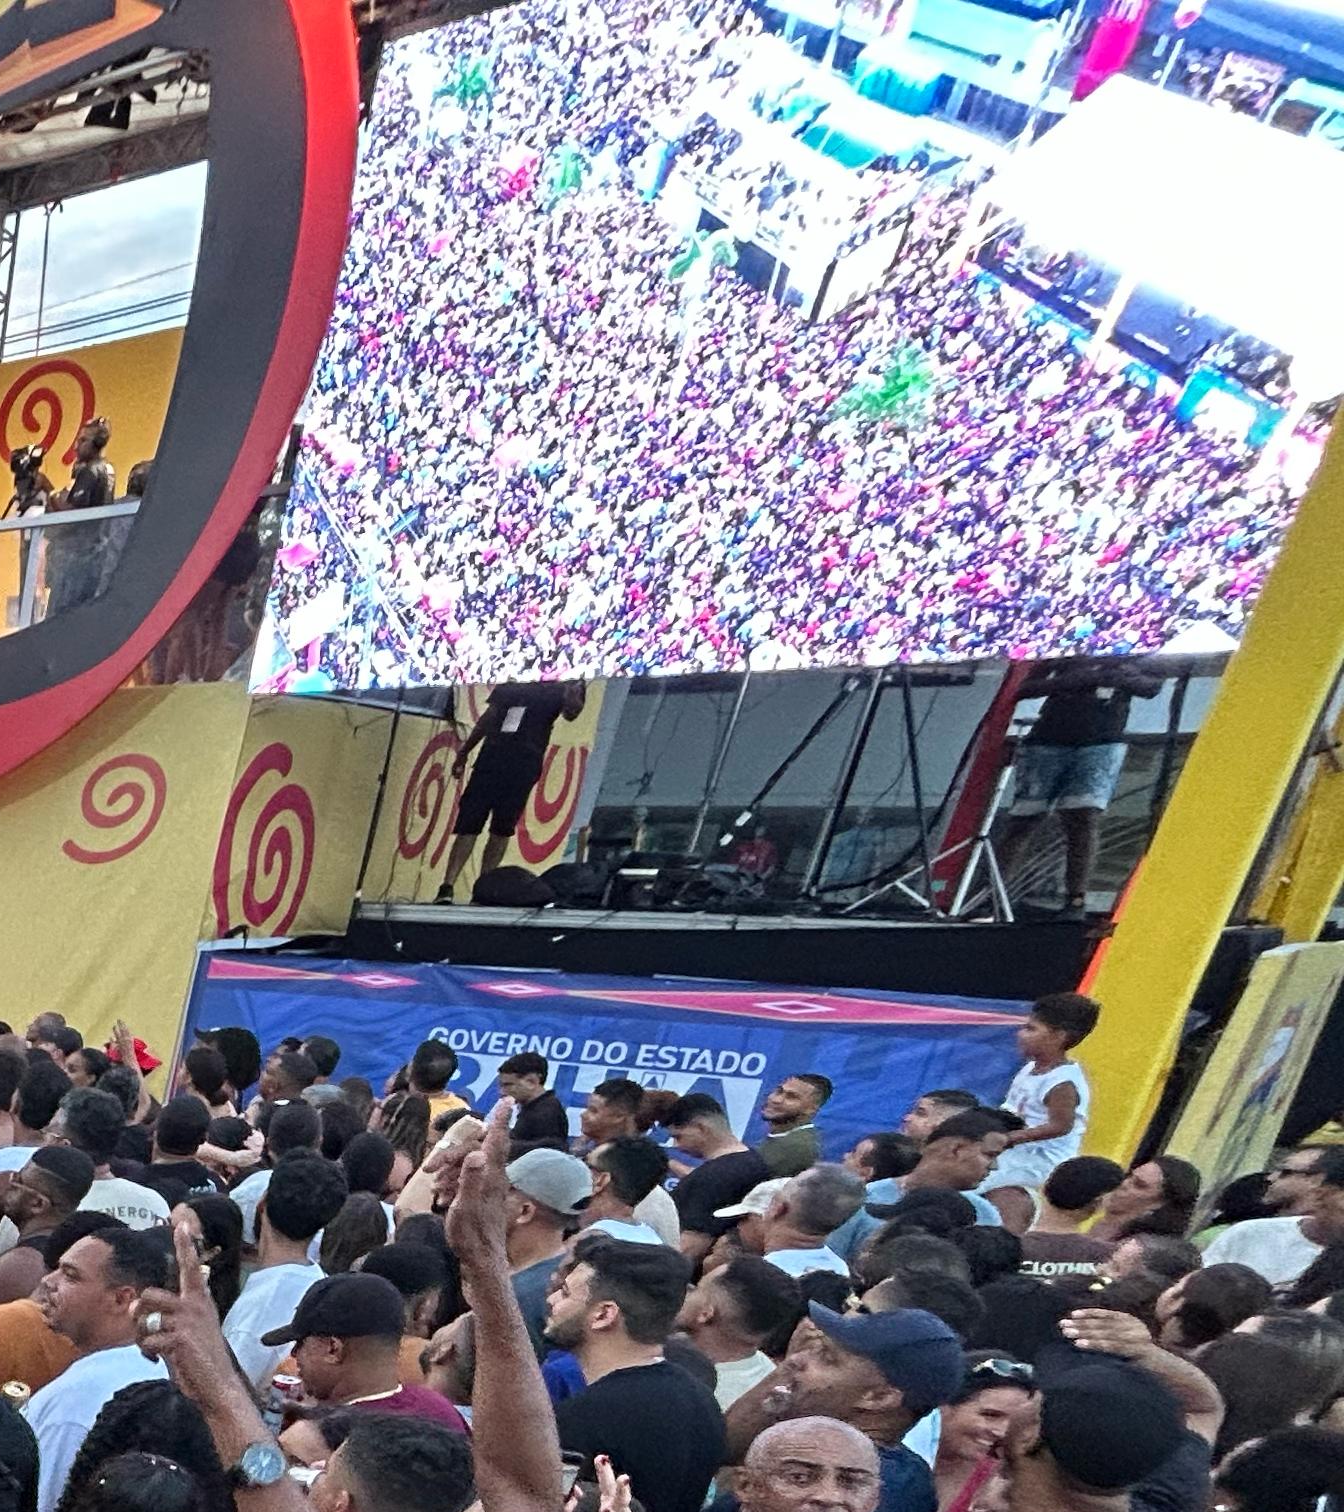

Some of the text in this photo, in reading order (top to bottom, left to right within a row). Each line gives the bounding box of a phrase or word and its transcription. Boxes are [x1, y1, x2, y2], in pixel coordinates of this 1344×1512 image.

[428, 1026, 768, 1077] GOVERNO DO ESTADO
